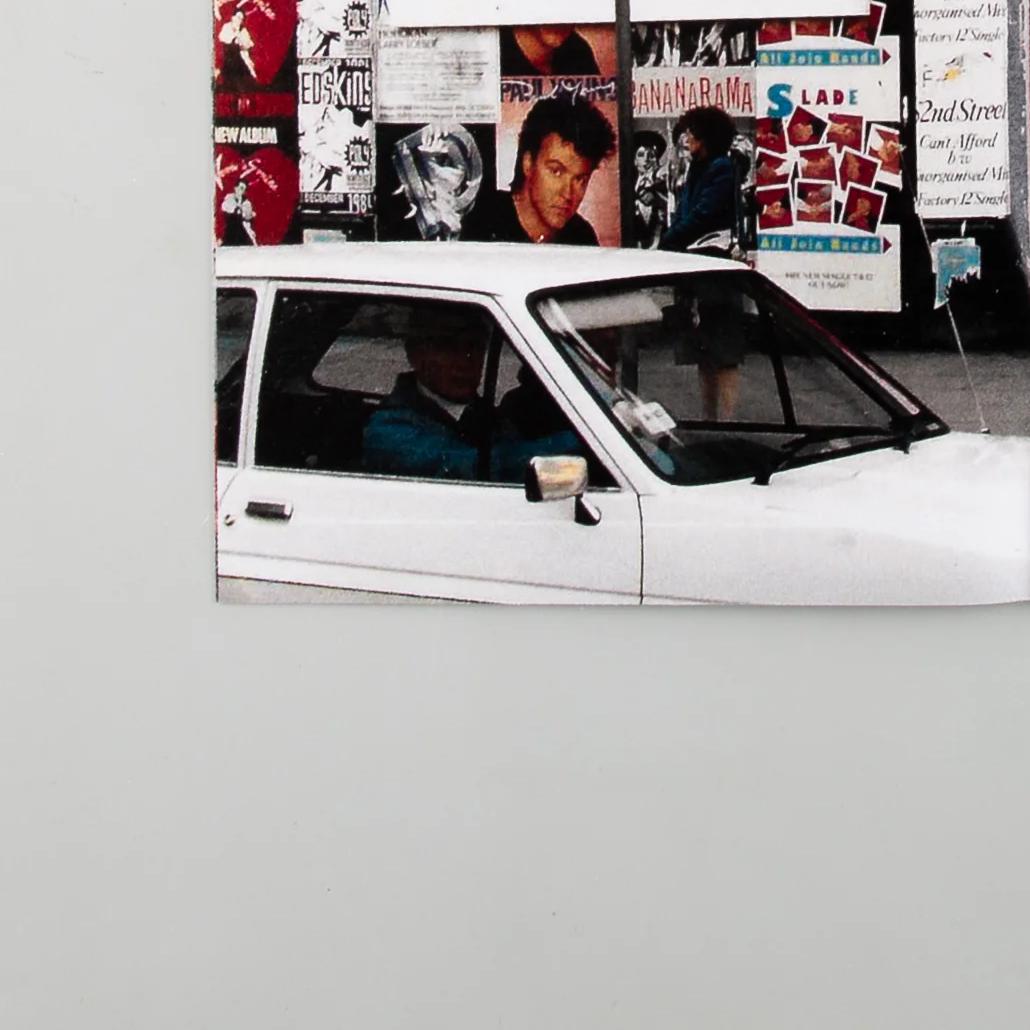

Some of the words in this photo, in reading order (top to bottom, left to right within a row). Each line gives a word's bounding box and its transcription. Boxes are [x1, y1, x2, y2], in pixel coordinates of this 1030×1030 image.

[767, 84, 858, 119] SLADE
[917, 99, 956, 123] 2nd
[956, 98, 1007, 122] Street
[239, 127, 278, 144] ALBUM
[760, 237, 783, 249] All
[790, 237, 823, 250] Join
